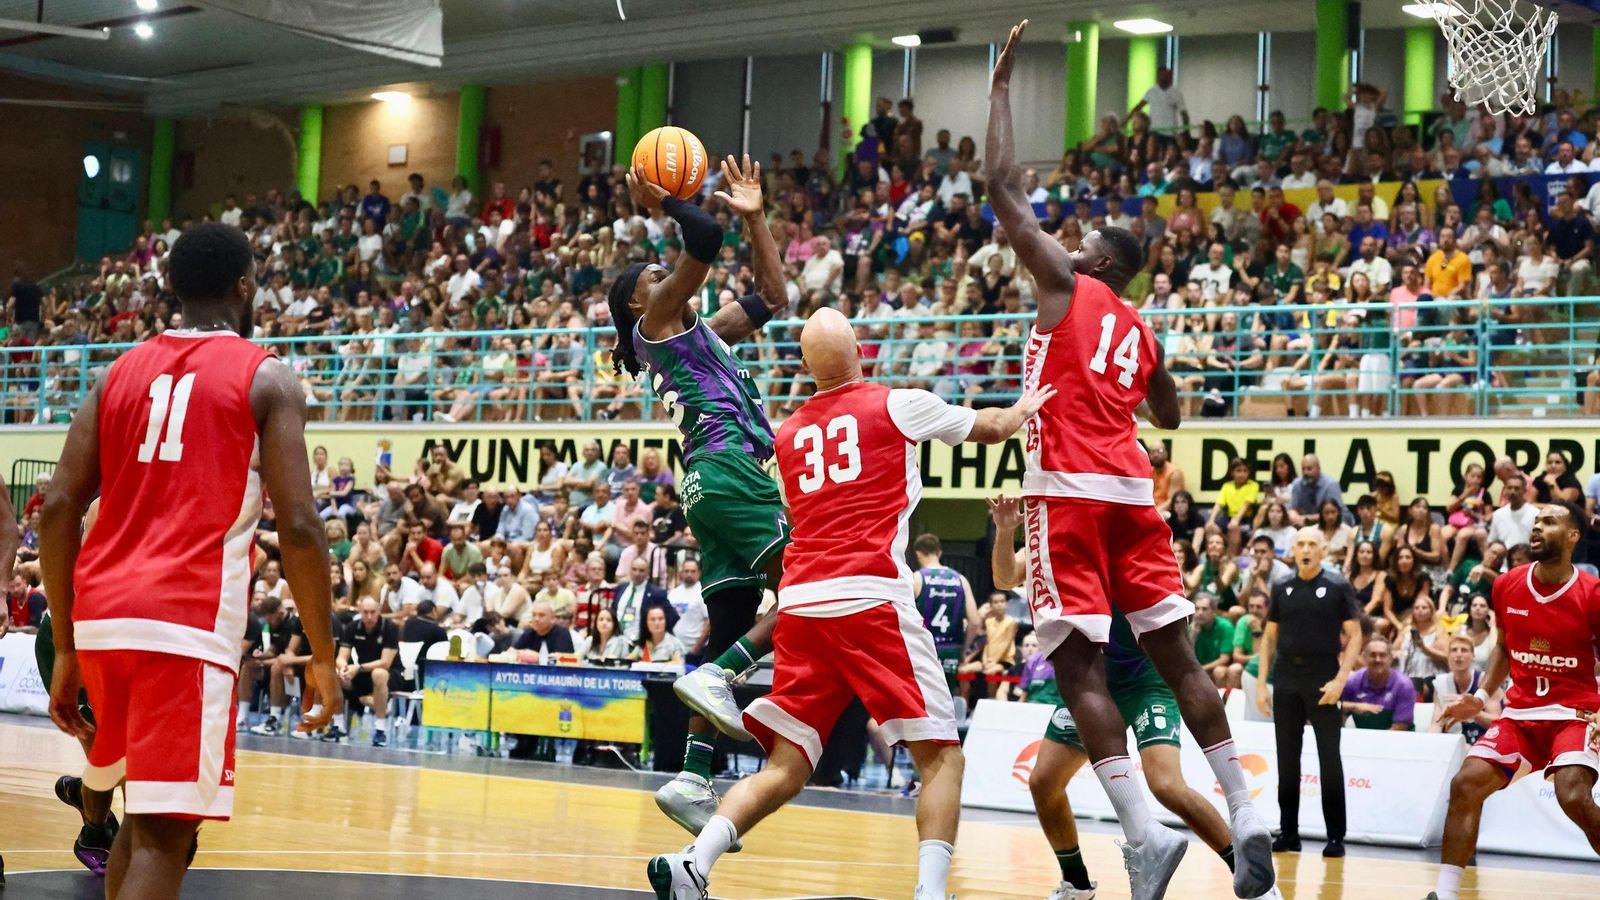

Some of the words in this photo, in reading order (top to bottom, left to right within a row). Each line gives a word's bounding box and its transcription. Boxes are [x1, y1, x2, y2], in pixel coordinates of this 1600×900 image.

[1089, 312, 1140, 389] 14
[137, 373, 196, 463] 11
[793, 414, 862, 494] 33
[687, 482, 702, 496] SOL
[930, 604, 951, 634] 4
[495, 672, 522, 685] AYTO.
[523, 674, 535, 686] DE
[584, 677, 597, 688] DE
[598, 678, 611, 690] LA
[612, 679, 643, 691] TORRE
[1348, 778, 1371, 789] SOL
